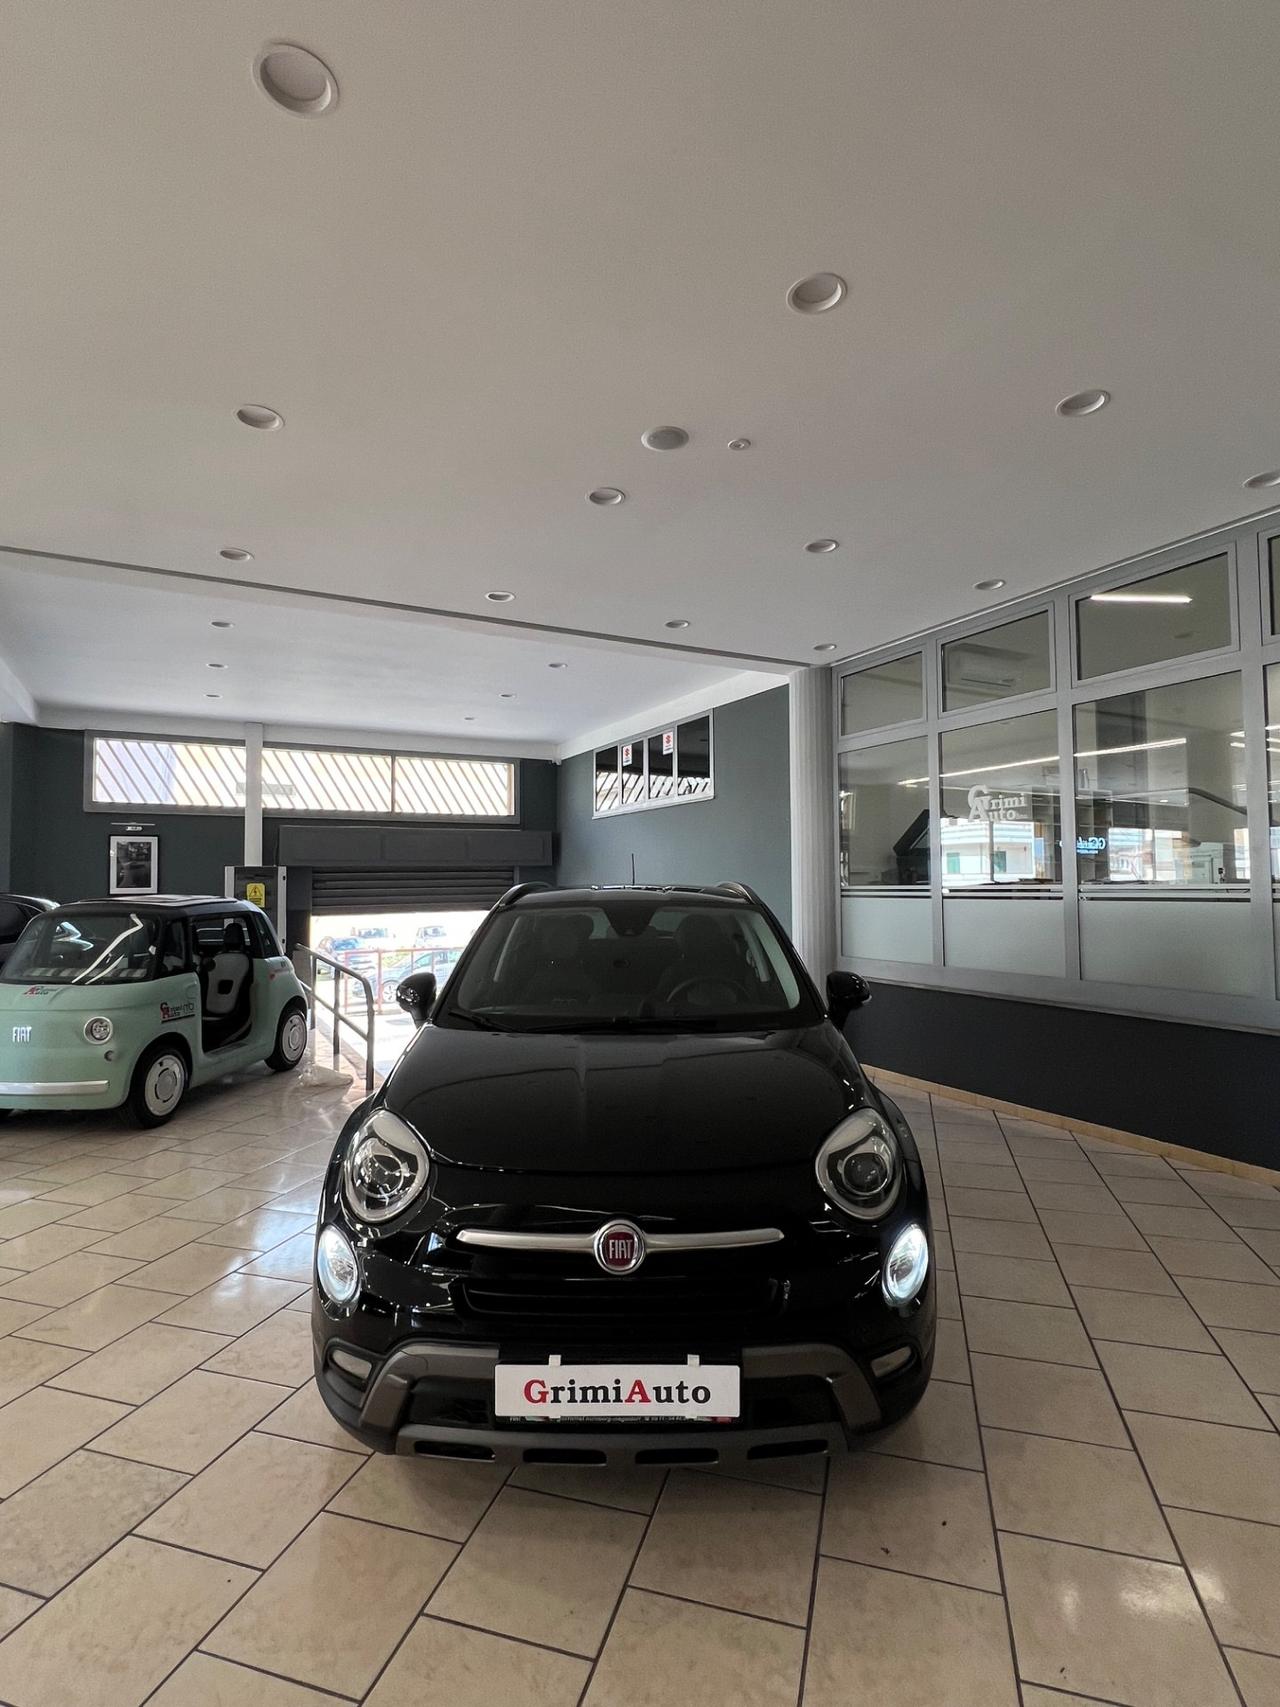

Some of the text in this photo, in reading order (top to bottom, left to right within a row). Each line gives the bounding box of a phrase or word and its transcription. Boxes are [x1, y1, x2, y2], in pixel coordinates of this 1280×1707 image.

[968, 785, 1028, 809] Grimi
[968, 798, 1016, 822] Auto
[12, 1026, 32, 1043] FIAT
[609, 1239, 633, 1259] FIAT
[523, 1378, 712, 1404] GrimiAuto
